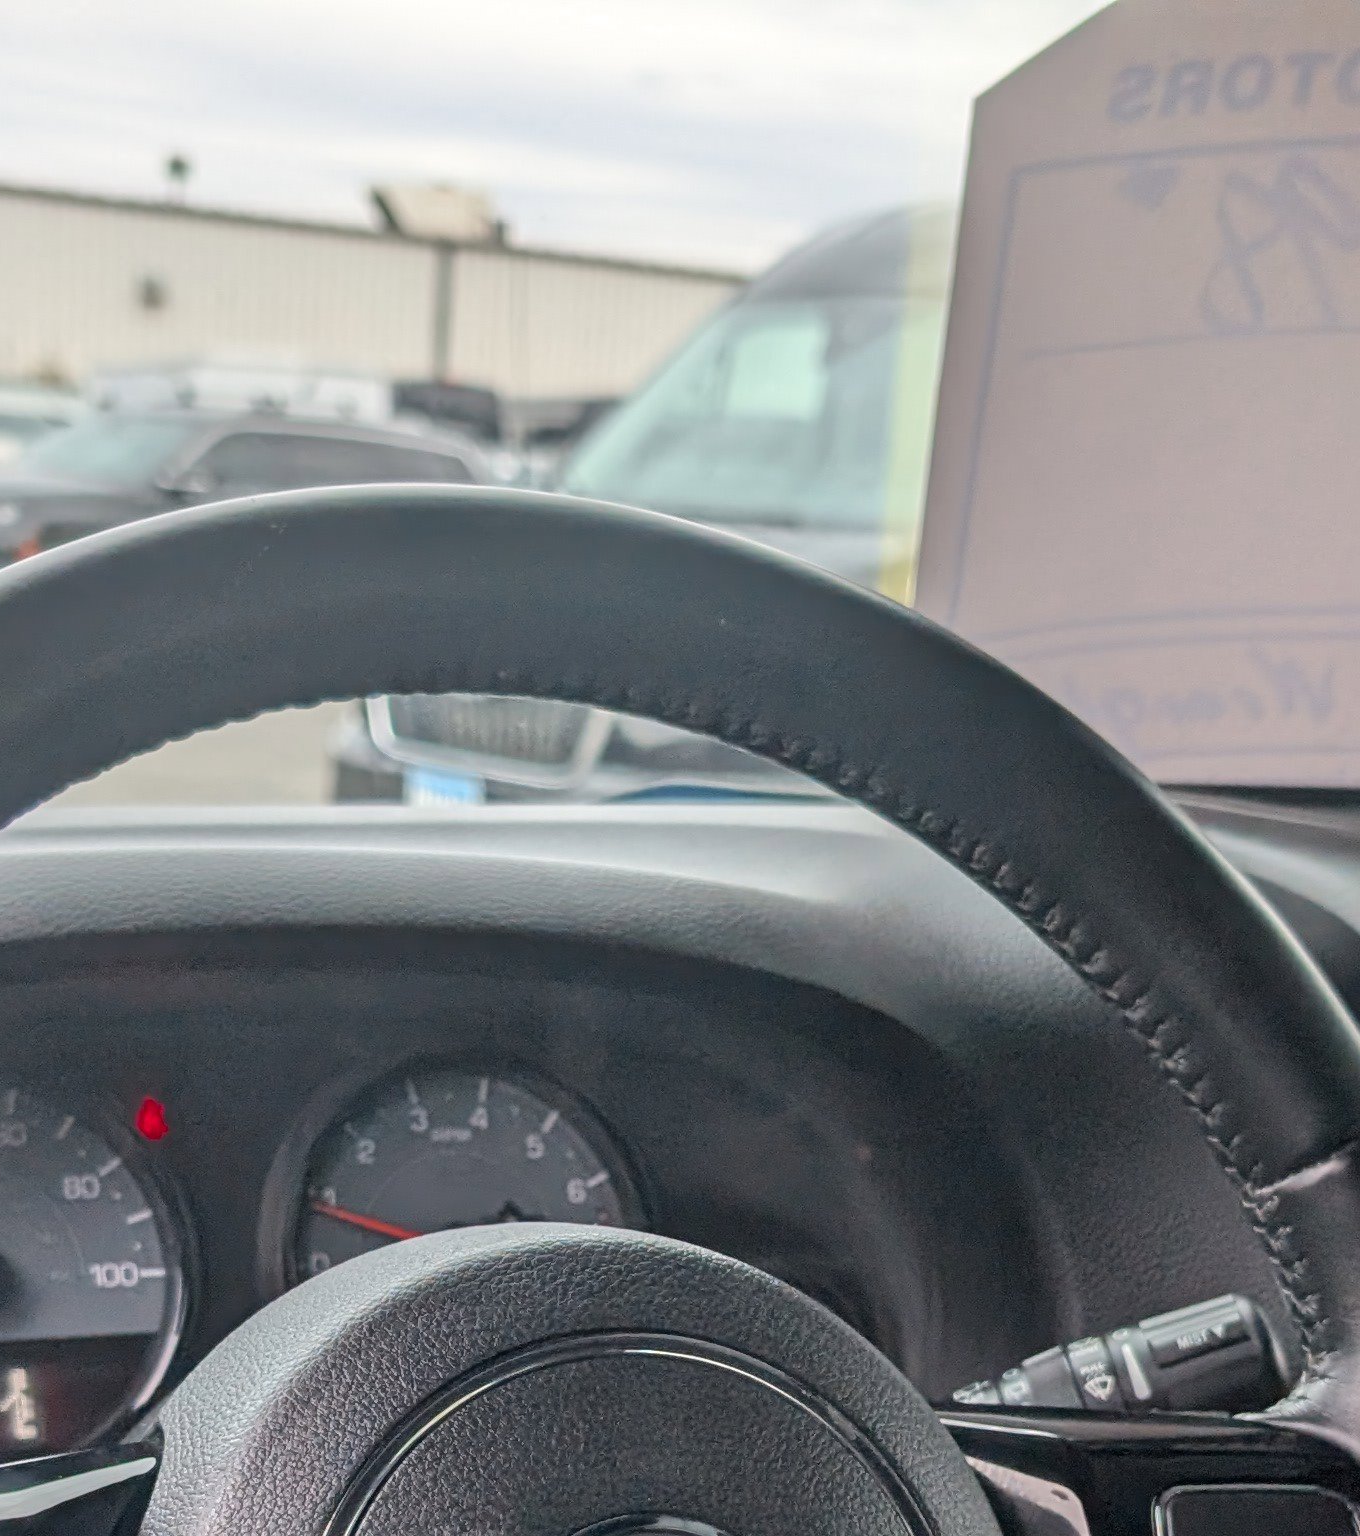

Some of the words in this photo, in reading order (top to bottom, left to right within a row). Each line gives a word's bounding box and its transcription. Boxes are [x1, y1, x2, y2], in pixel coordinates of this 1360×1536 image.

[409, 1105, 428, 1133] 3
[470, 1106, 488, 1130] 4
[356, 1138, 375, 1164] 2
[526, 1133, 545, 1160] 5
[63, 1174, 101, 1201] 80
[567, 1177, 587, 1204] 6
[90, 1261, 139, 1288] 100
